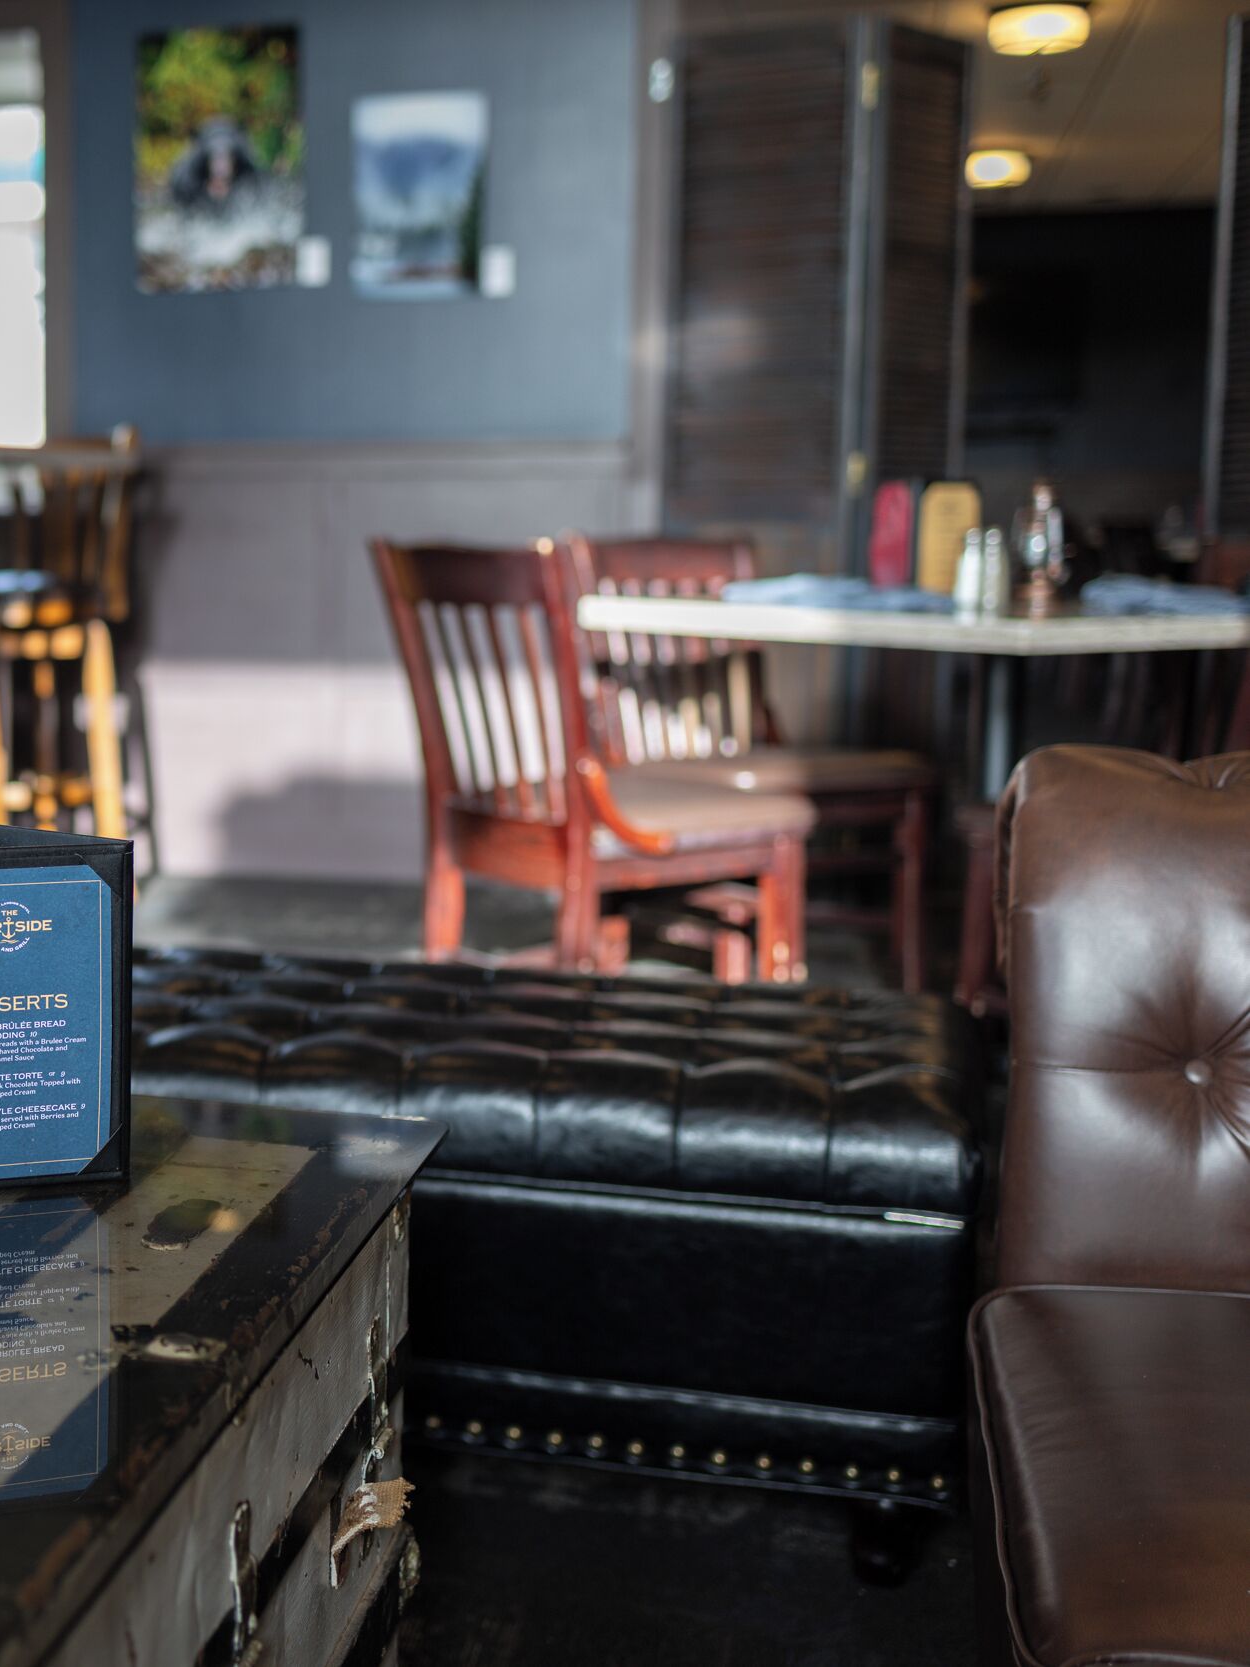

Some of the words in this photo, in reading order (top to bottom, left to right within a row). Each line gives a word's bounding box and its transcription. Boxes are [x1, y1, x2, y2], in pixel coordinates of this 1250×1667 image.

[15, 937, 30, 950] GRILL
[34, 1020, 66, 1028] BREAD
[13, 1072, 42, 1080] TORTE
[15, 1104, 76, 1113] CHEESECAKE
